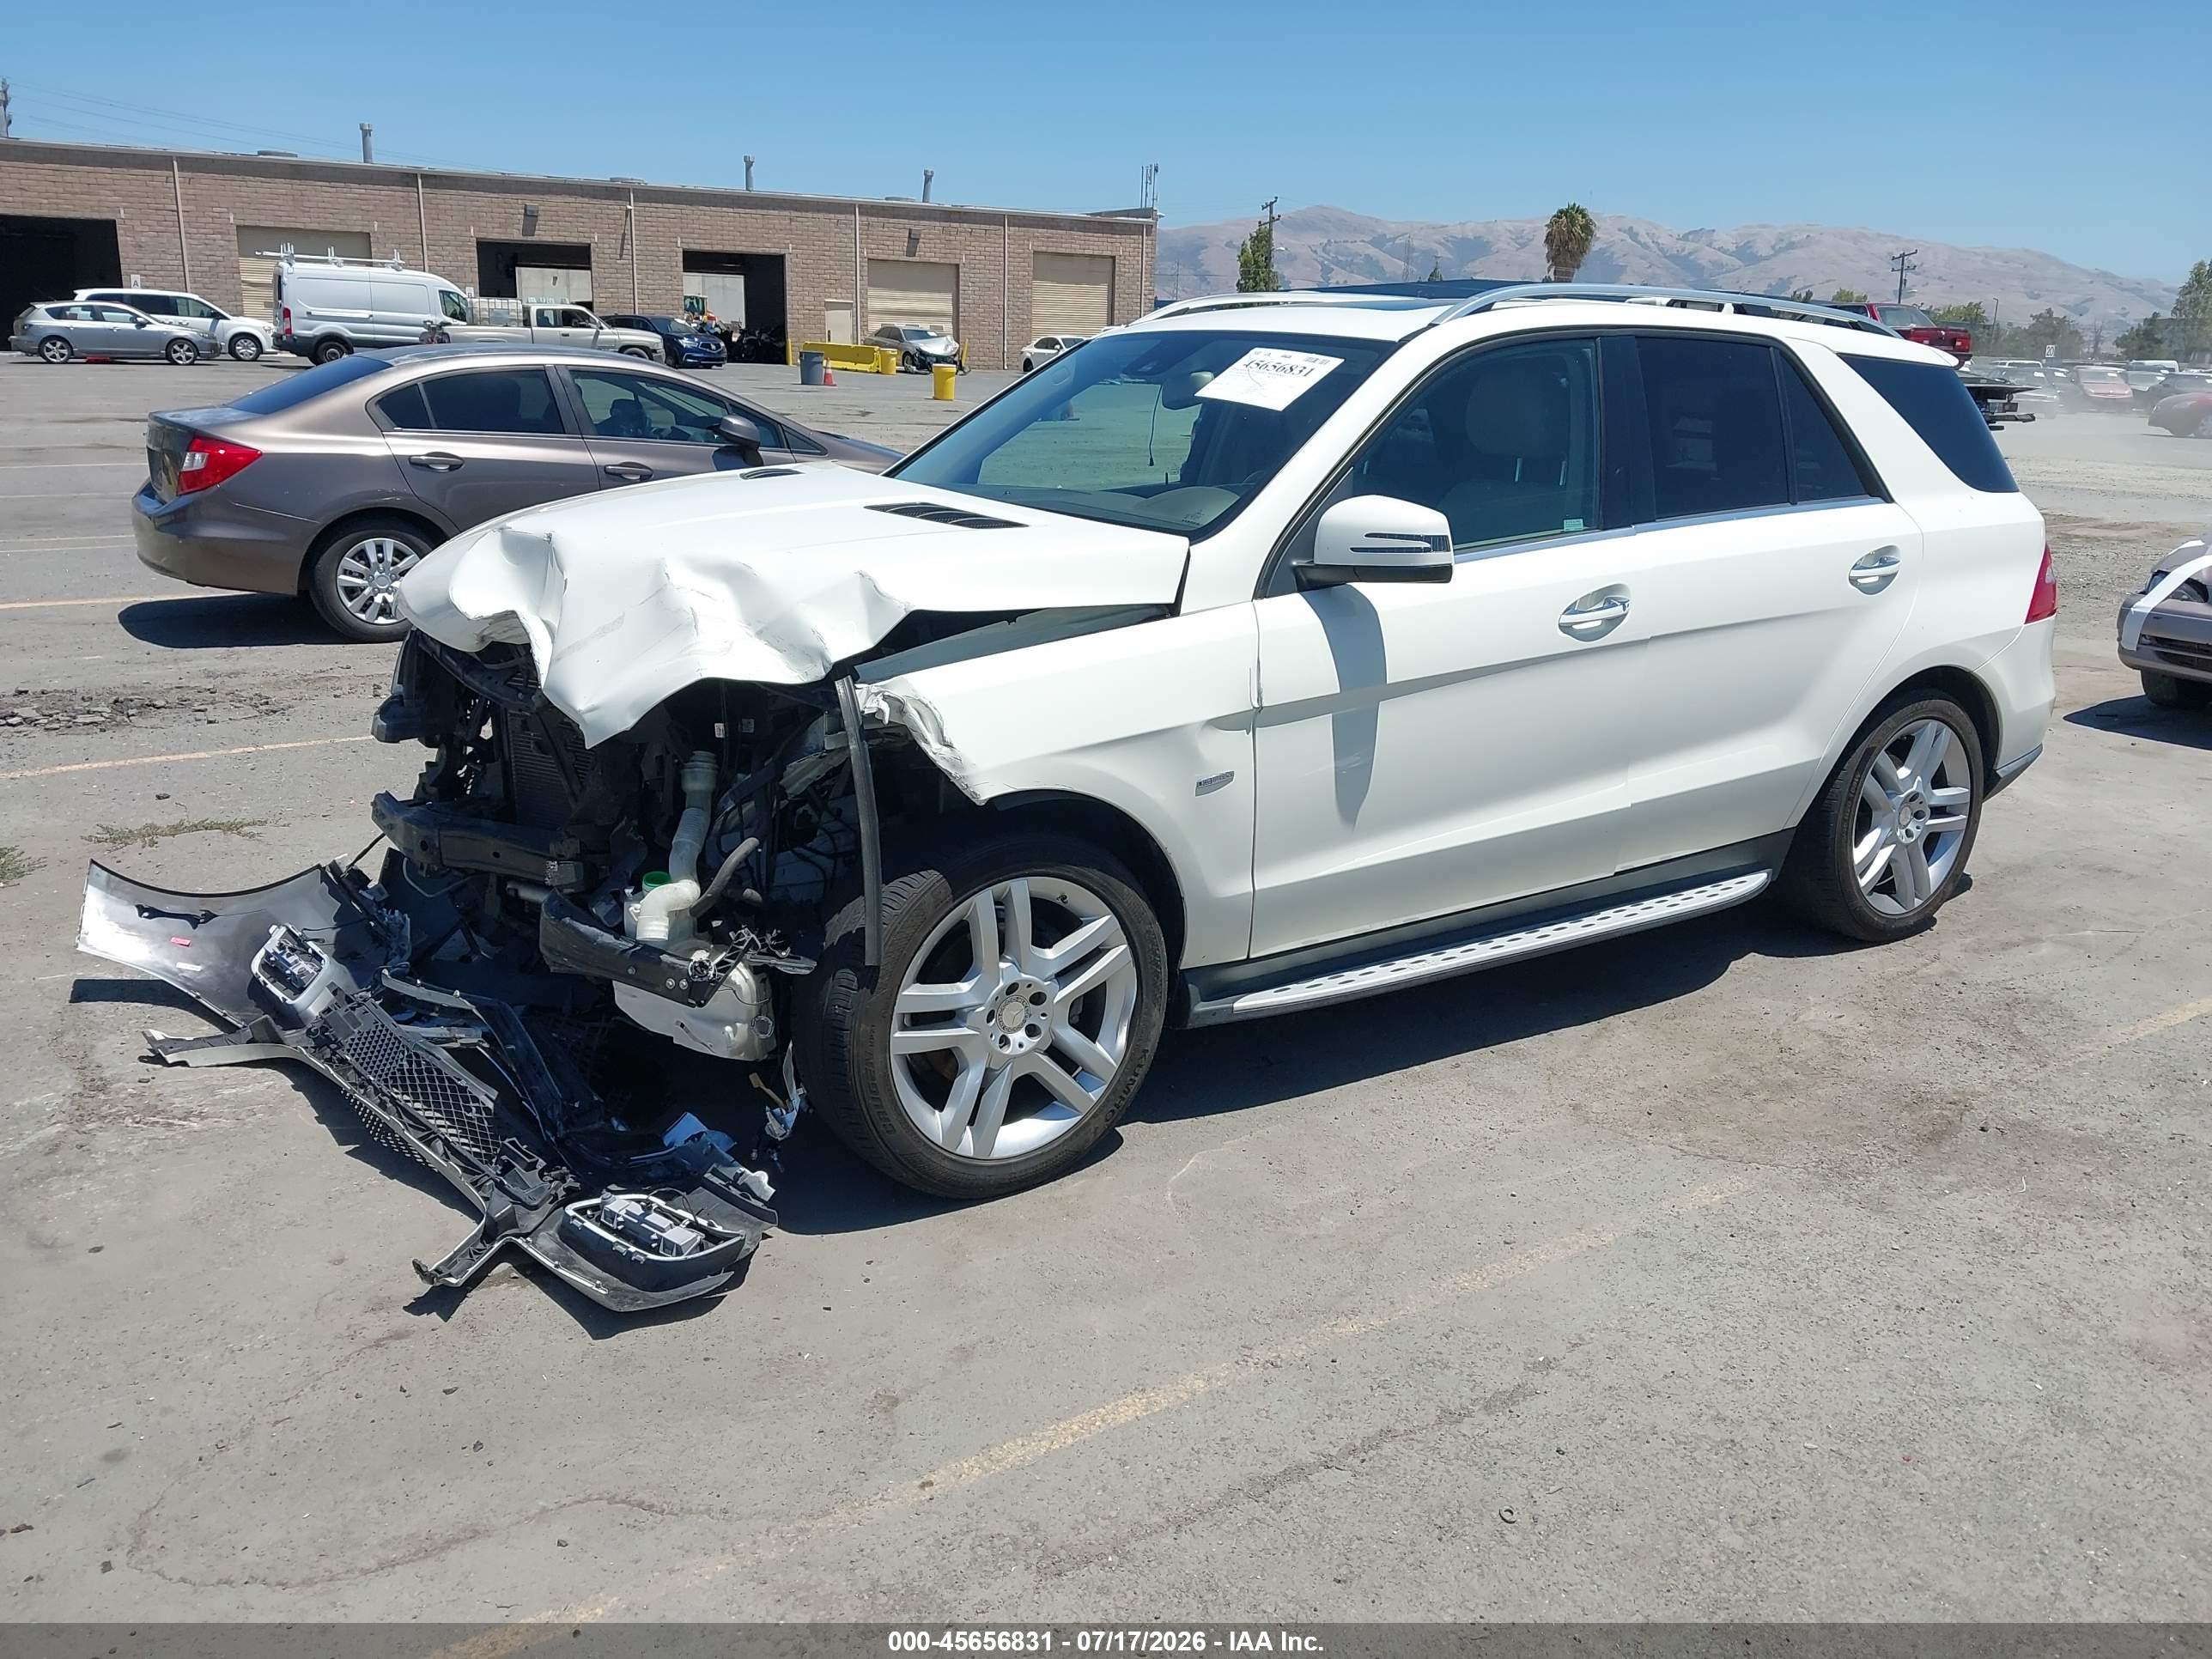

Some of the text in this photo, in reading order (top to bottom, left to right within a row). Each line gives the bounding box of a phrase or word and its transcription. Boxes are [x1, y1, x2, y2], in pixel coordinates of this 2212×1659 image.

[2047, 346, 2055, 356] 20
[1243, 360, 1316, 377] 45656831
[1104, 1048, 1150, 1122] KUMHO
